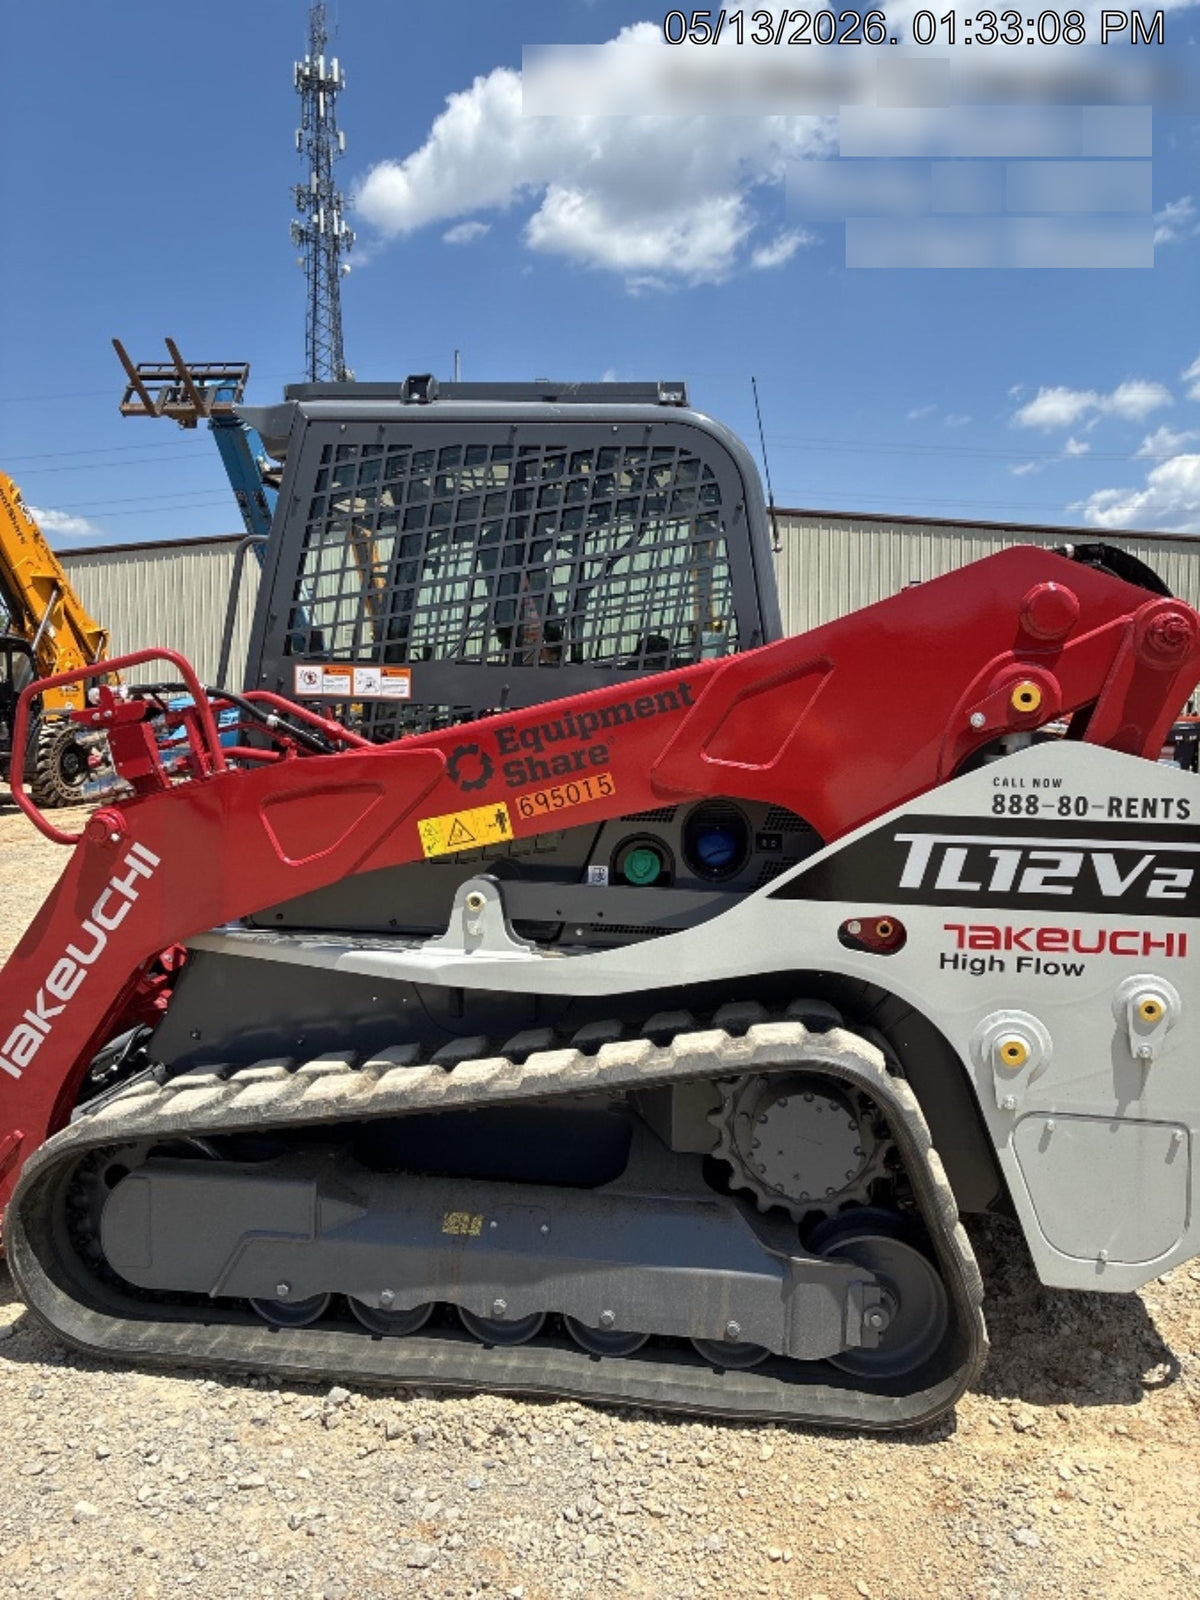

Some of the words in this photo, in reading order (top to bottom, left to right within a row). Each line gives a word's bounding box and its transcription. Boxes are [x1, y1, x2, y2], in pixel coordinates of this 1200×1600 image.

[494, 681, 696, 755] Equipment
[502, 743, 610, 788] Share
[993, 776, 1026, 788] CALL
[1032, 777, 1063, 789] NOW
[519, 774, 614, 818] 695015
[991, 794, 1191, 820] 888-80-RENTS
[894, 833, 1195, 899] TL12V2
[943, 923, 1188, 958] TAKEUCHI
[939, 952, 1006, 976] High
[1015, 956, 1086, 977] Flow
